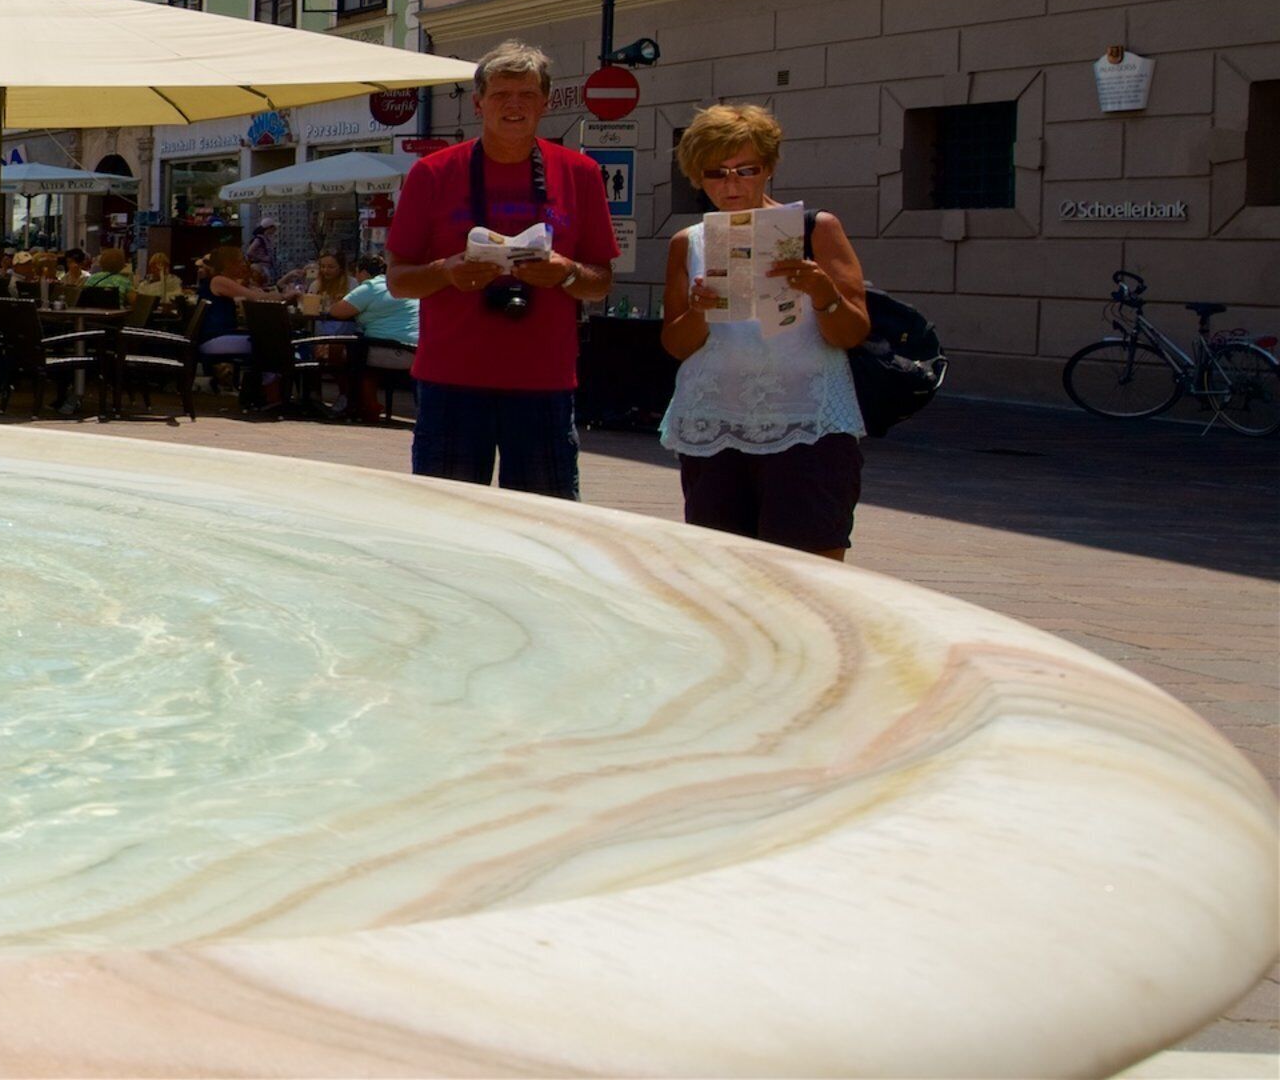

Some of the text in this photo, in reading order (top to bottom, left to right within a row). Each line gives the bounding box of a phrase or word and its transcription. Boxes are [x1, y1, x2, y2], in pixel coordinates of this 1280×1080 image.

[382, 100, 416, 119] Trafik
[305, 121, 360, 138] Porzellan
[588, 124, 635, 132] ausgenommen
[39, 179, 95, 191] ALTER PLATZ
[228, 189, 255, 198] TRAFIK
[320, 183, 345, 192] ALTEN
[367, 181, 392, 192] PLATZ
[1077, 200, 1187, 218] Schoellerbank
